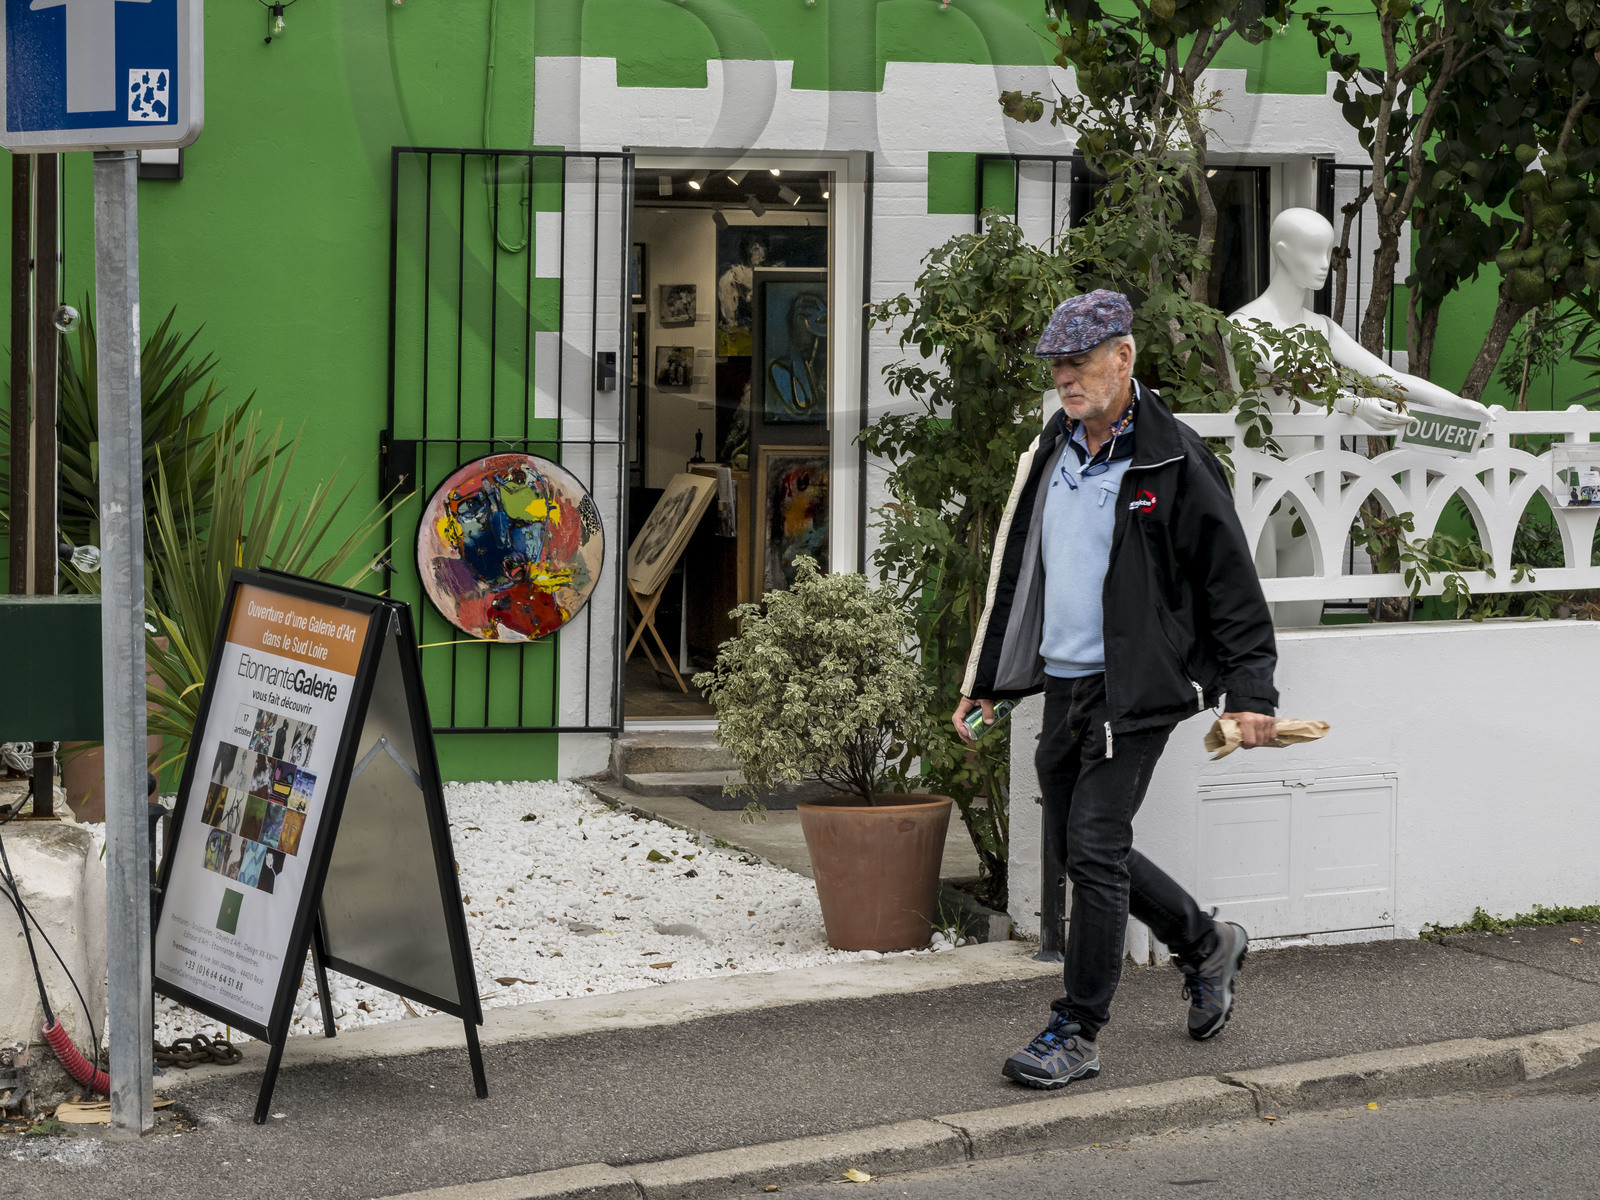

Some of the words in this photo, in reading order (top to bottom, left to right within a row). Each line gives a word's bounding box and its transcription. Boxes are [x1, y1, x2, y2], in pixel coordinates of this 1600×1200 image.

[1405, 418, 1479, 447] OUVERT
[247, 600, 284, 624] Ouverture
[285, 610, 307, 629] d'une
[308, 616, 335, 637] Galerie
[336, 624, 356, 642] d'Art
[262, 629, 281, 648] dans
[282, 635, 291, 650] le
[292, 637, 308, 654] Sud
[308, 641, 328, 660] Loire
[238, 653, 337, 702] EtonnanteGalerie
[252, 689, 267, 702] vous
[268, 692, 280, 706] fait
[280, 696, 312, 715] découvrir
[244, 714, 249, 722] 17
[234, 726, 252, 737] artistes
[172, 940, 197, 957] Trentemoult
[211, 942, 234, 957] Etonnantes
[236, 951, 258, 967] Rencontres
[244, 943, 258, 956] Design
[185, 960, 195, 970] +33
[219, 974, 227, 984] 64
[228, 977, 234, 987] 51
[235, 980, 243, 991] 88
[220, 987, 264, 1012] EtonnanteGalerie.com
